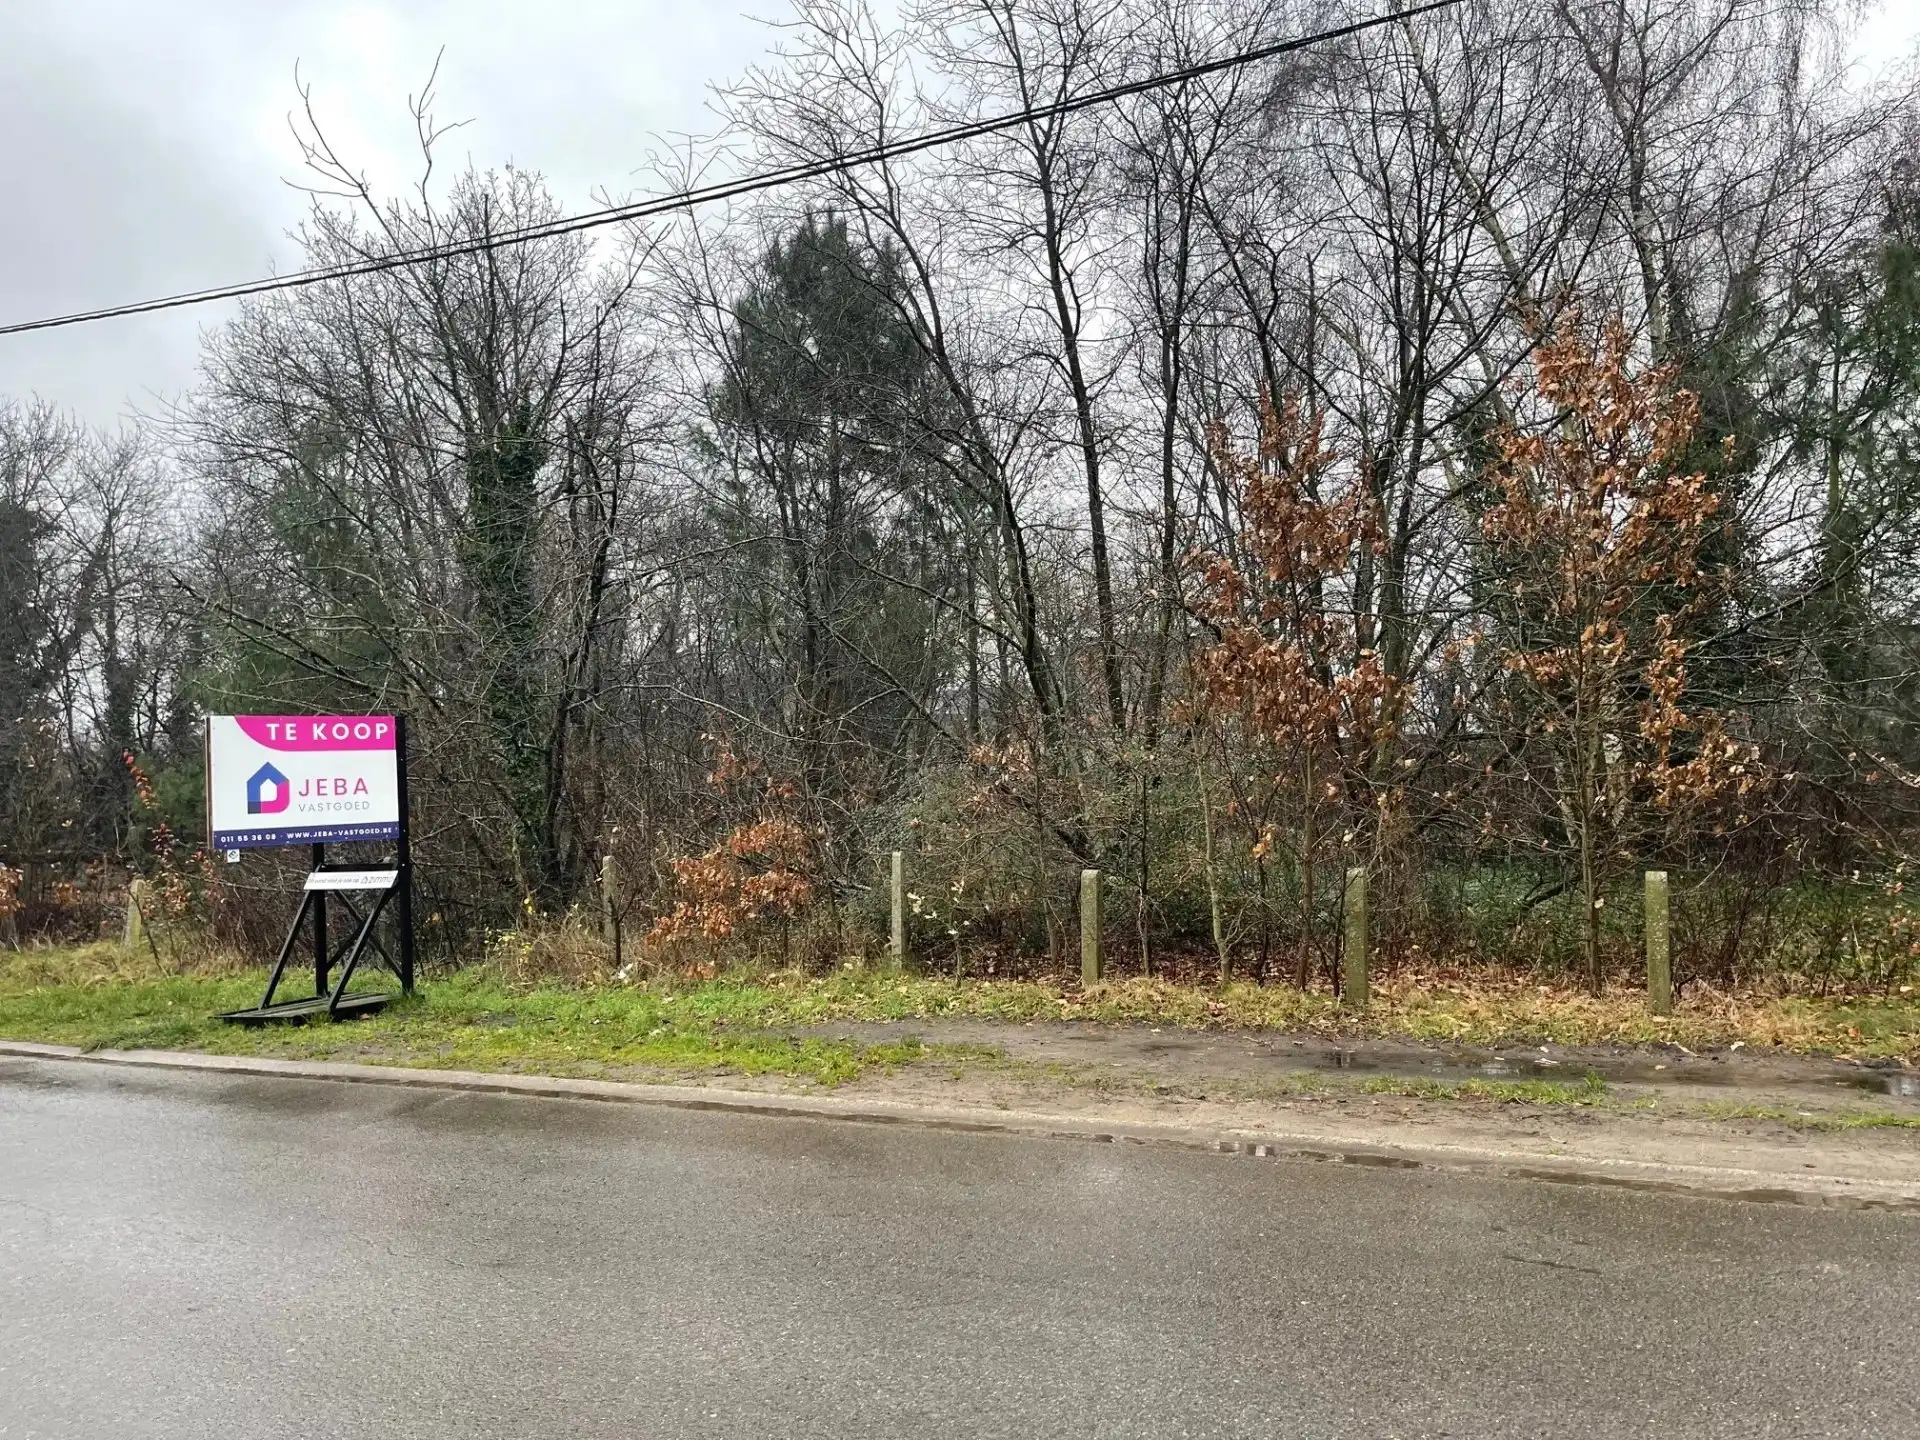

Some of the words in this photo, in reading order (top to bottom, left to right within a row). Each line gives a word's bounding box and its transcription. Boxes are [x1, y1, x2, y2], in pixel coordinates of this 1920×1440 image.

[265, 722, 297, 741] TE
[312, 722, 388, 740] KOOP
[298, 777, 369, 797] JEBA
[298, 800, 370, 812] VASTGOED
[286, 827, 392, 839] WWW.JEBA-VASTGOED.BE
